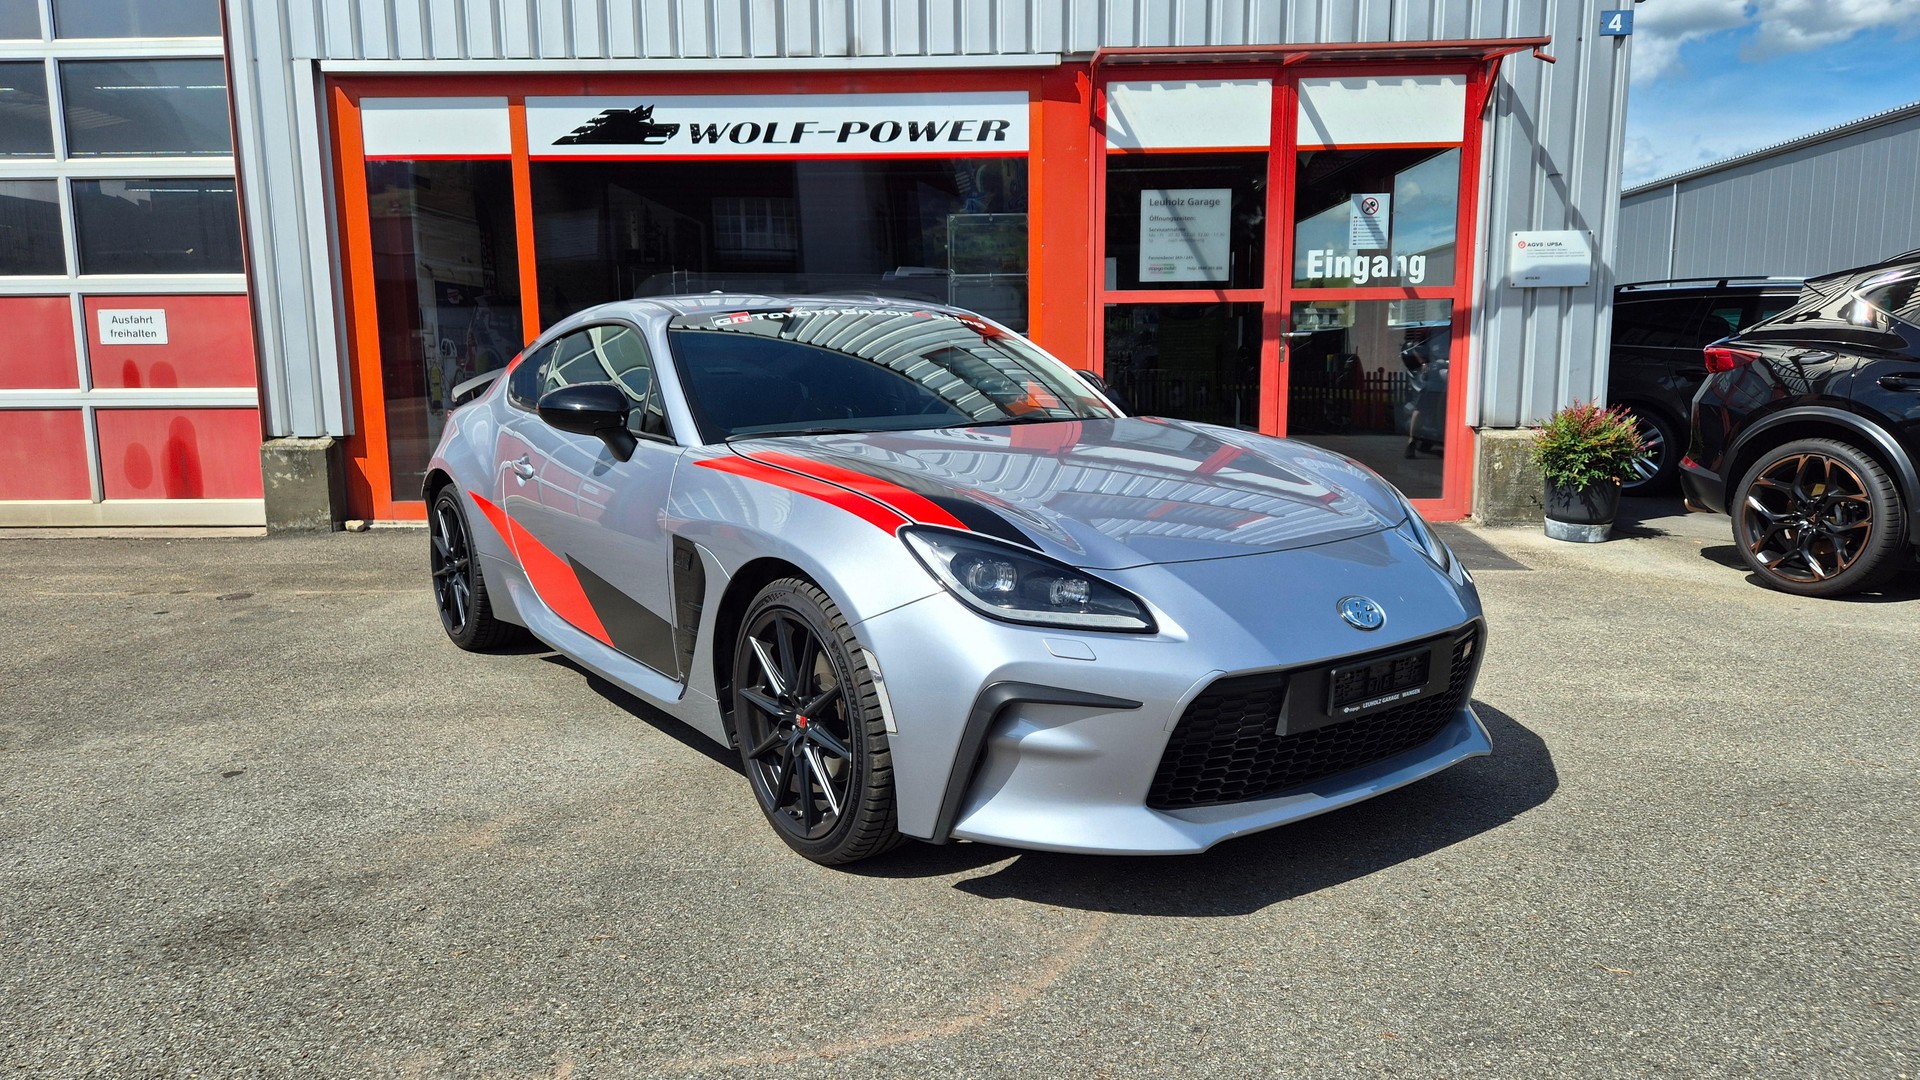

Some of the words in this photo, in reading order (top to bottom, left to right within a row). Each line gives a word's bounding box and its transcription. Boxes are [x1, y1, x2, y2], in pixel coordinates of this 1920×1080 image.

[1608, 13, 1622, 32] 4
[689, 119, 1011, 145] WOLF-POWER
[1149, 198, 1185, 207] Leuholz
[1187, 197, 1221, 208] Garage
[1307, 249, 1426, 285] Eingang
[111, 315, 154, 324] Ausfahrt
[715, 313, 751, 327] GR
[750, 309, 838, 321] TOYOTA
[840, 308, 912, 317] GAZOO
[110, 328, 157, 338] freihalten
[837, 656, 860, 720] MICHELIN
[1362, 699, 1382, 708] LEUHOLZ
[1382, 694, 1399, 703] GARAGE
